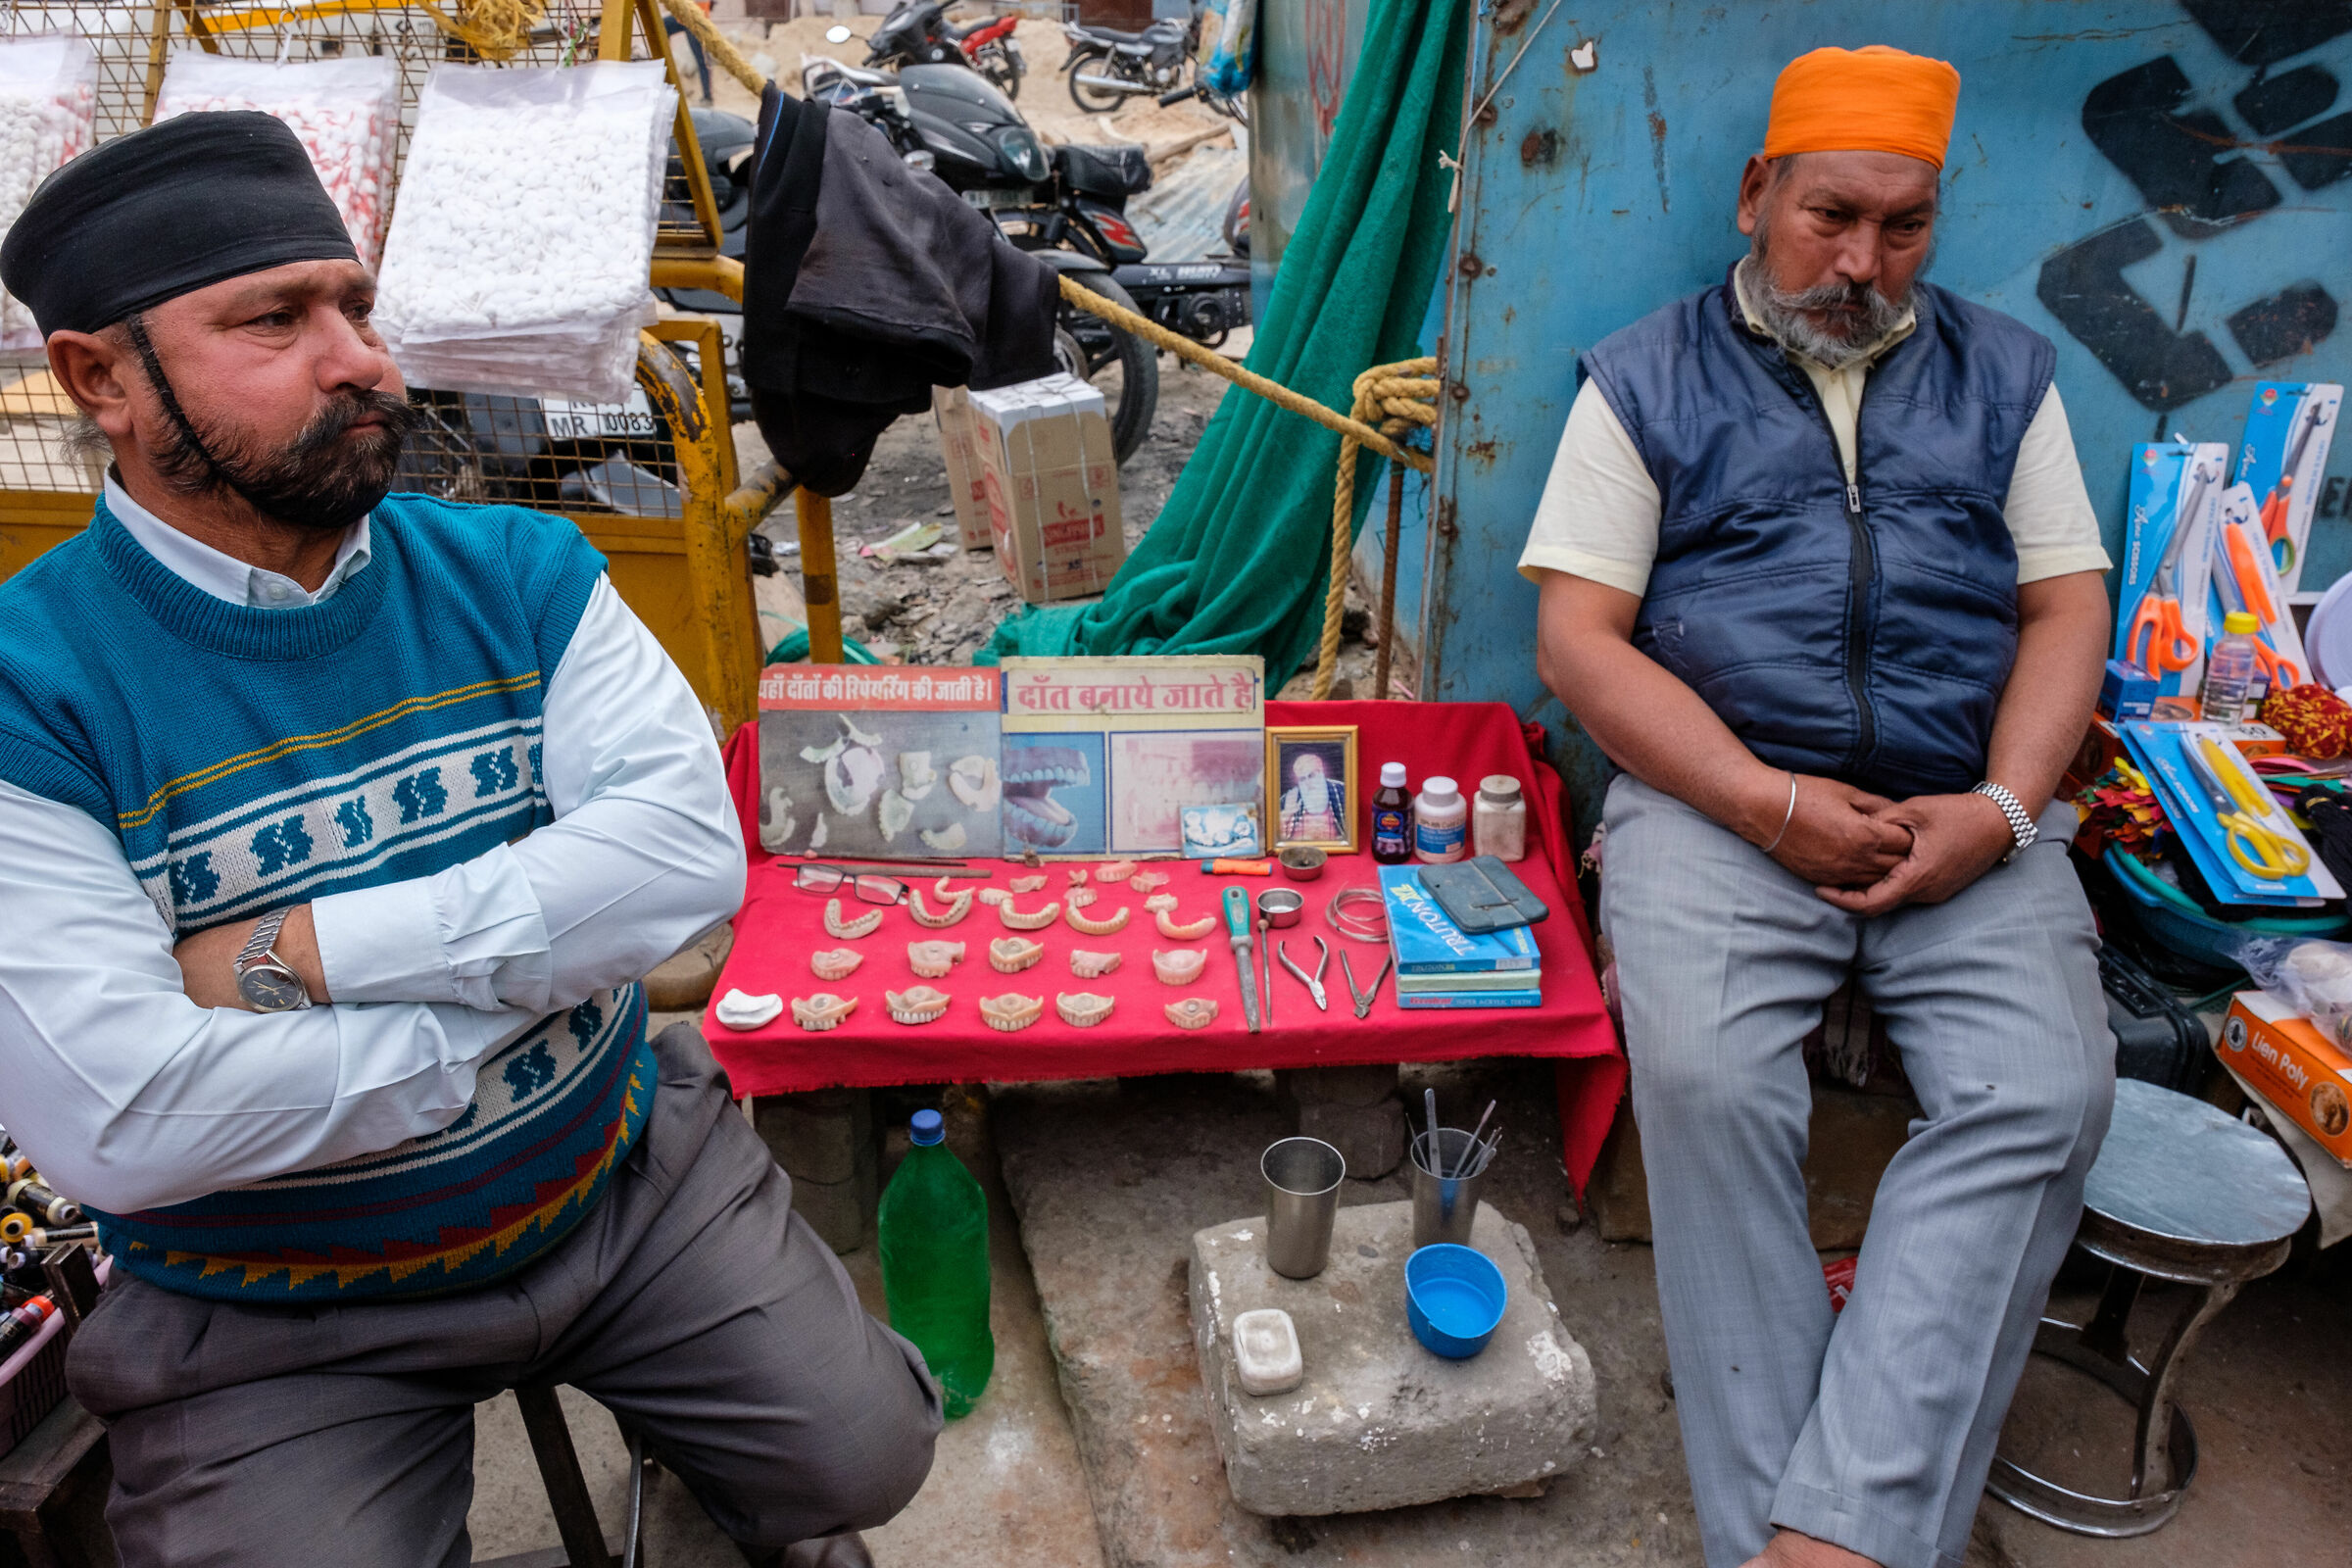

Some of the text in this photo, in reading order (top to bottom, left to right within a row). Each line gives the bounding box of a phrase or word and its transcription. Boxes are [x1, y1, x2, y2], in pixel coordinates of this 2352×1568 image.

[822, 674, 844, 700] की
[912, 674, 932, 701] की
[935, 675, 971, 701] जाती
[1016, 671, 1253, 710] दाँत बनाये जाते है
[2251, 1030, 2278, 1065] Lien
[2279, 1053, 2309, 1090] Poly
